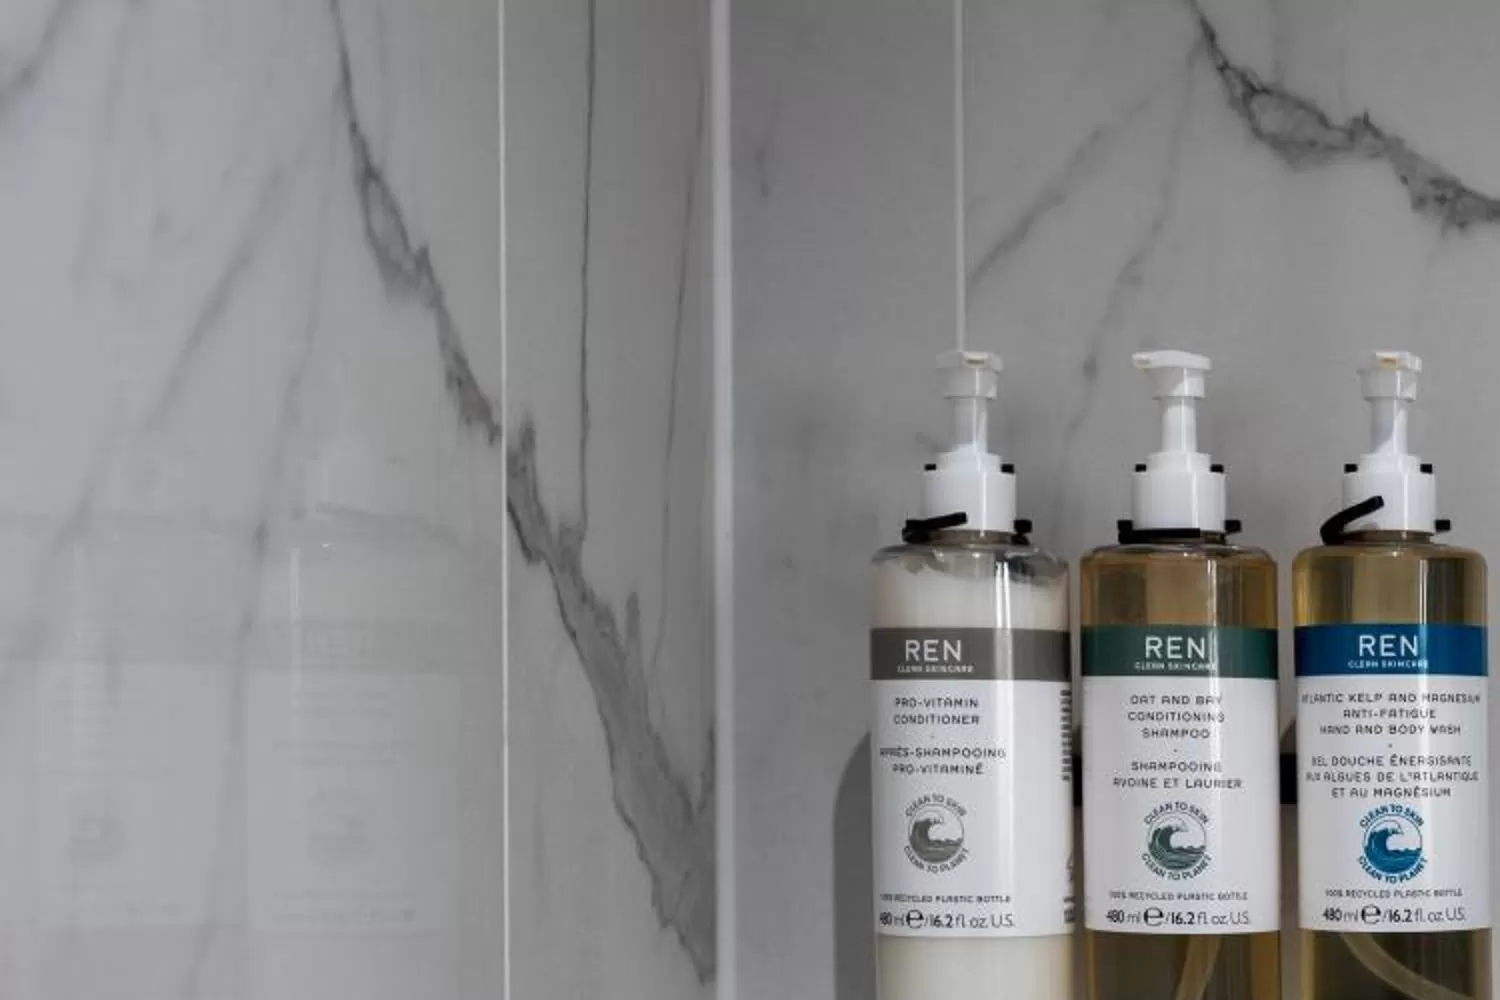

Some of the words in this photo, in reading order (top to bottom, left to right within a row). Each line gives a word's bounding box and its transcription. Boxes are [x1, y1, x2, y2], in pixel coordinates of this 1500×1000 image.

[905, 639, 962, 662] REN
[1145, 636, 1205, 659] REN
[1358, 634, 1419, 657] REN
[1347, 660, 1378, 669] CLEAN
[895, 697, 978, 709] PRO-VITAMIN
[1130, 694, 1156, 705] OAT
[1161, 694, 1190, 705] AND
[1195, 694, 1223, 705] BAY
[1348, 692, 1382, 703] KELP
[1388, 692, 1417, 703] AND
[1343, 707, 1437, 719] ANTI-FATIGUE
[893, 714, 980, 725] CONDITIONER
[1141, 728, 1210, 739] SHAMPOO
[1319, 723, 1350, 735] HAND
[1355, 723, 1383, 735] AND
[1389, 723, 1425, 735] BODY
[1429, 723, 1462, 735] WASH
[1131, 761, 1223, 773] SHAMPOOING
[1331, 755, 1384, 767] DOUCHE
[1323, 771, 1371, 783] ALGUES
[1377, 771, 1394, 783] DE
[1162, 778, 1180, 789] ET
[1185, 778, 1243, 789] LAURIER
[1331, 787, 1345, 798] ET
[1350, 787, 1368, 798] AU
[1373, 785, 1451, 798] MAGNÉSIUM
[1143, 802, 1173, 825] CLEAN
[1175, 801, 1188, 812] TO
[1189, 804, 1209, 824] SKIN
[1359, 805, 1389, 828] CLEAN
[1390, 803, 1403, 813] TO
[1403, 807, 1424, 827] SKIN
[1141, 853, 1166, 878] CLEAN
[1167, 871, 1181, 881] TO
[1182, 854, 1212, 880] PLANET
[1357, 855, 1382, 881] CLEAN
[1385, 874, 1398, 884] TO
[1399, 857, 1428, 883] PLANET
[1105, 908, 1124, 925] 480
[1322, 907, 1342, 922] 480
